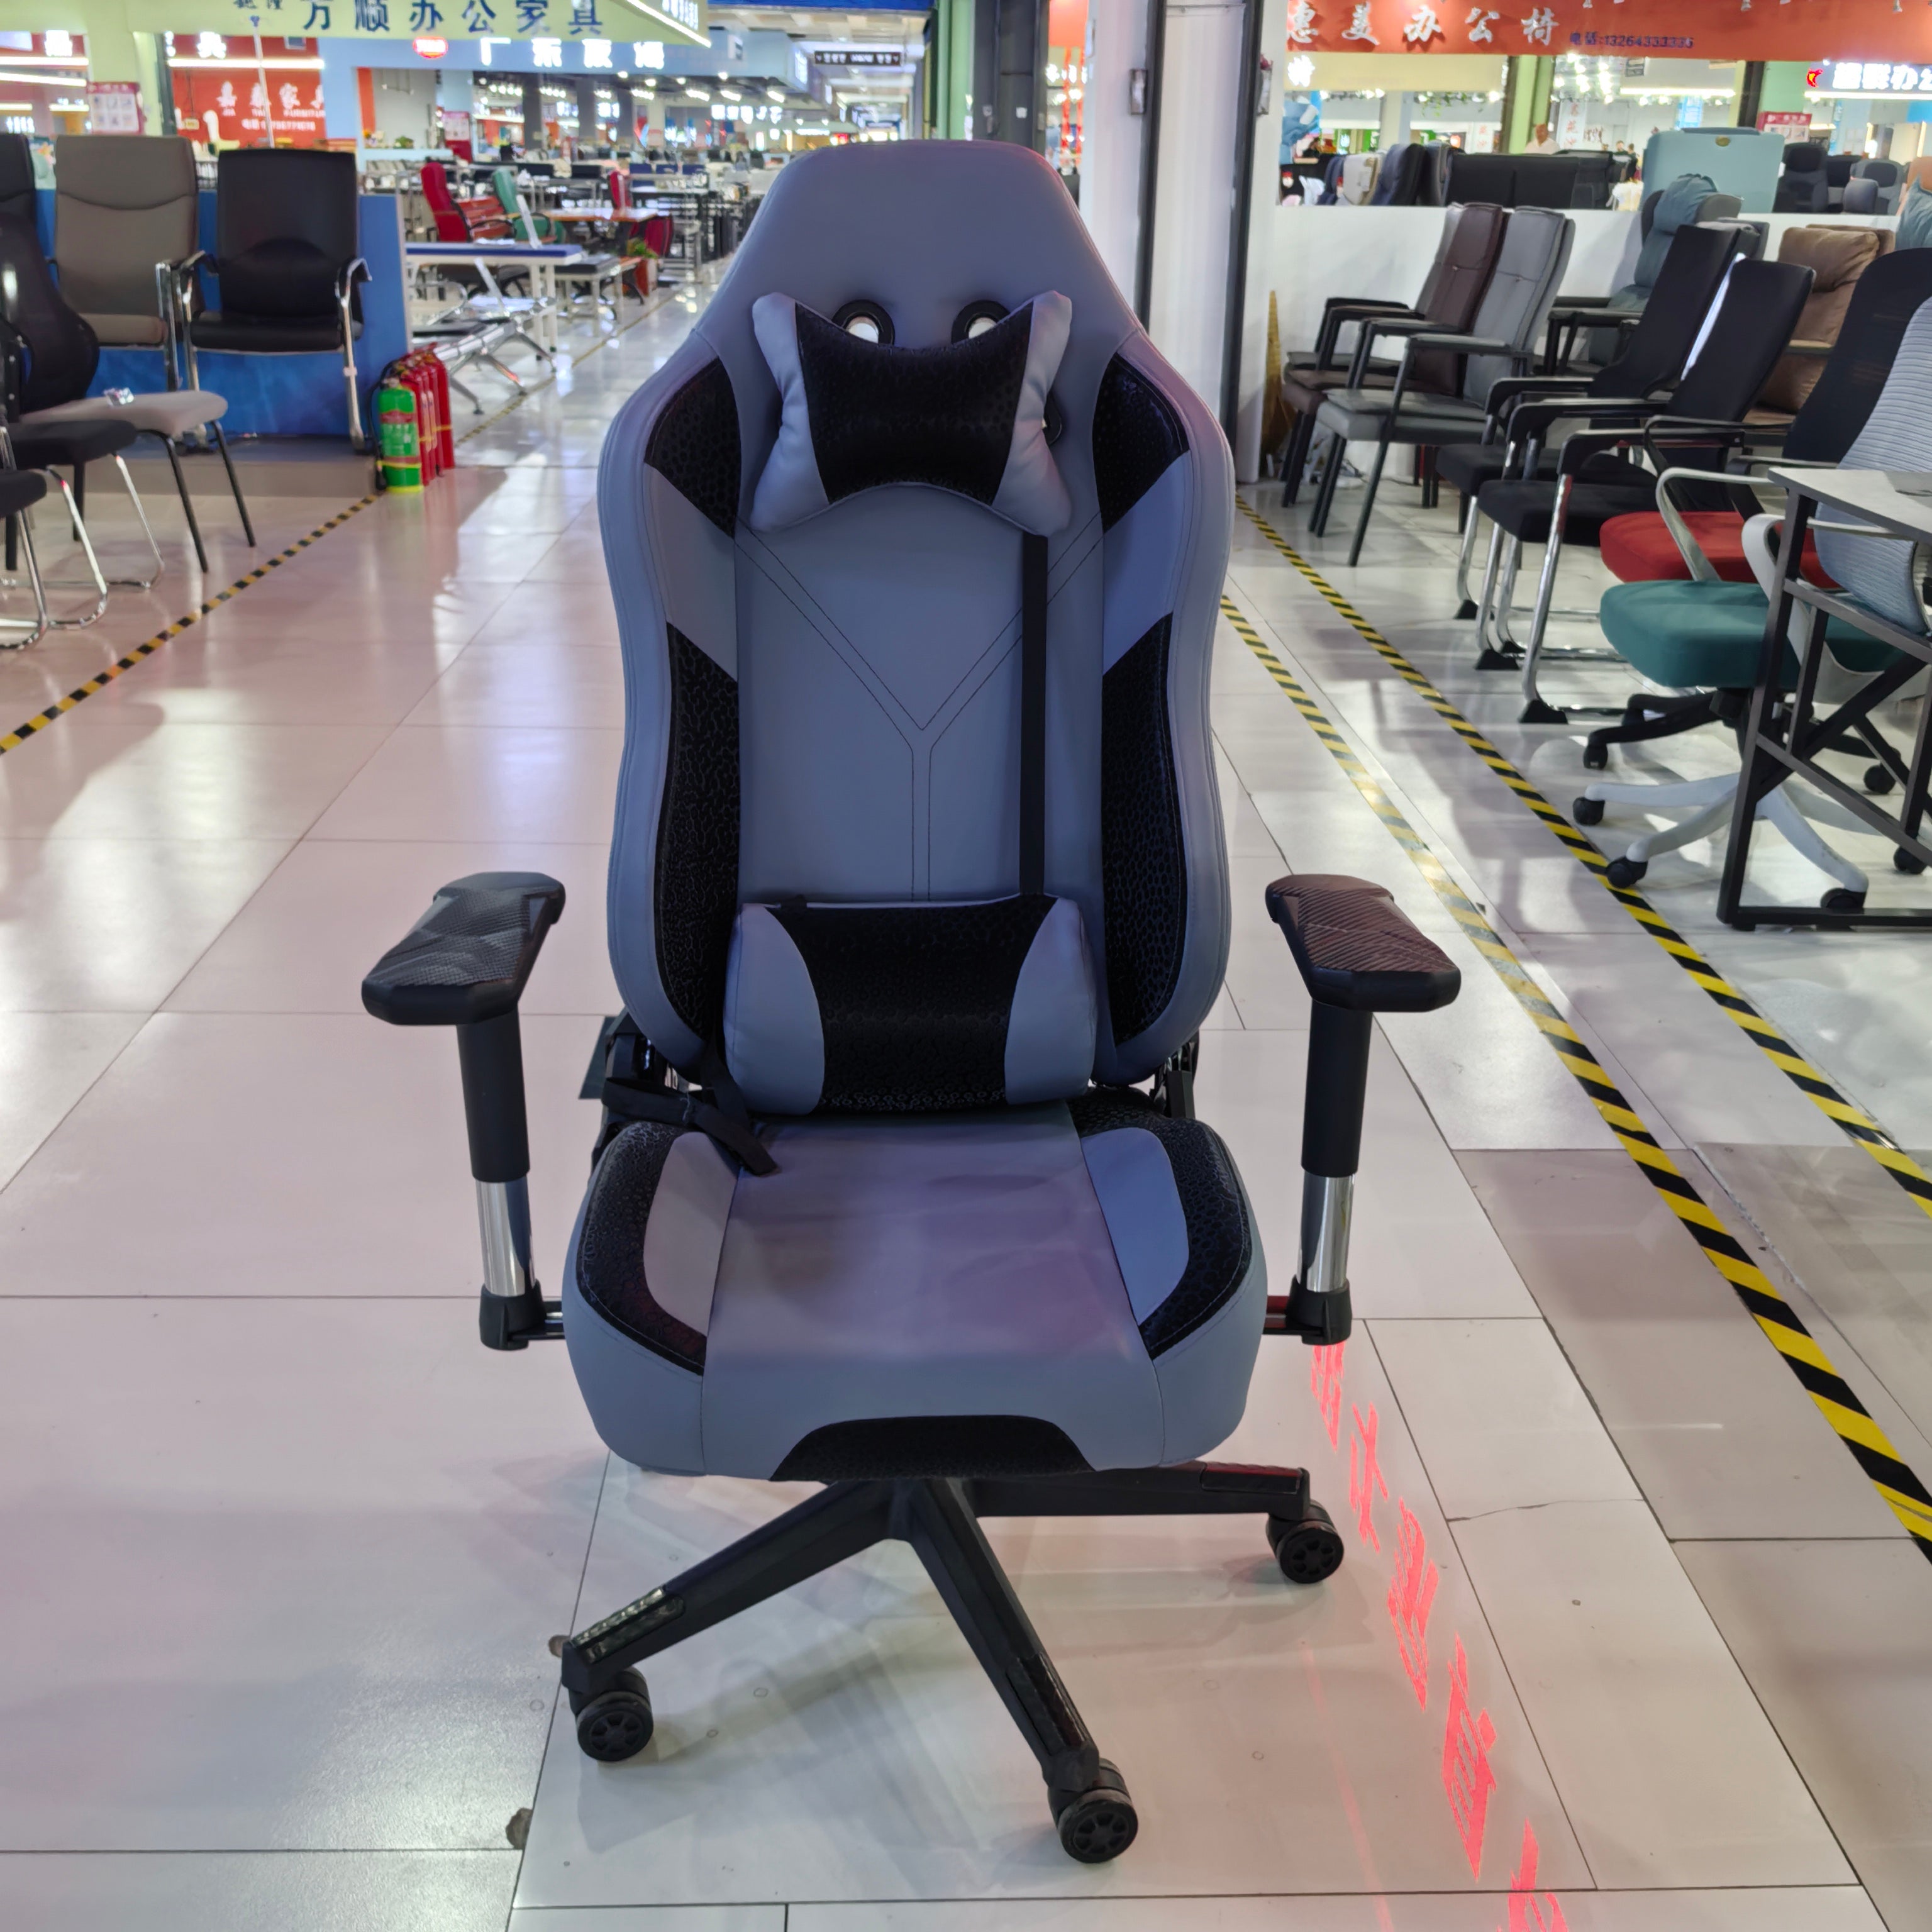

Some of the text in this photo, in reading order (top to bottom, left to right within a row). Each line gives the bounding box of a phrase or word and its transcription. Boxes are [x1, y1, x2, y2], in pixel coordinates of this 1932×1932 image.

[303, 0, 602, 34] 方顺办公家具
